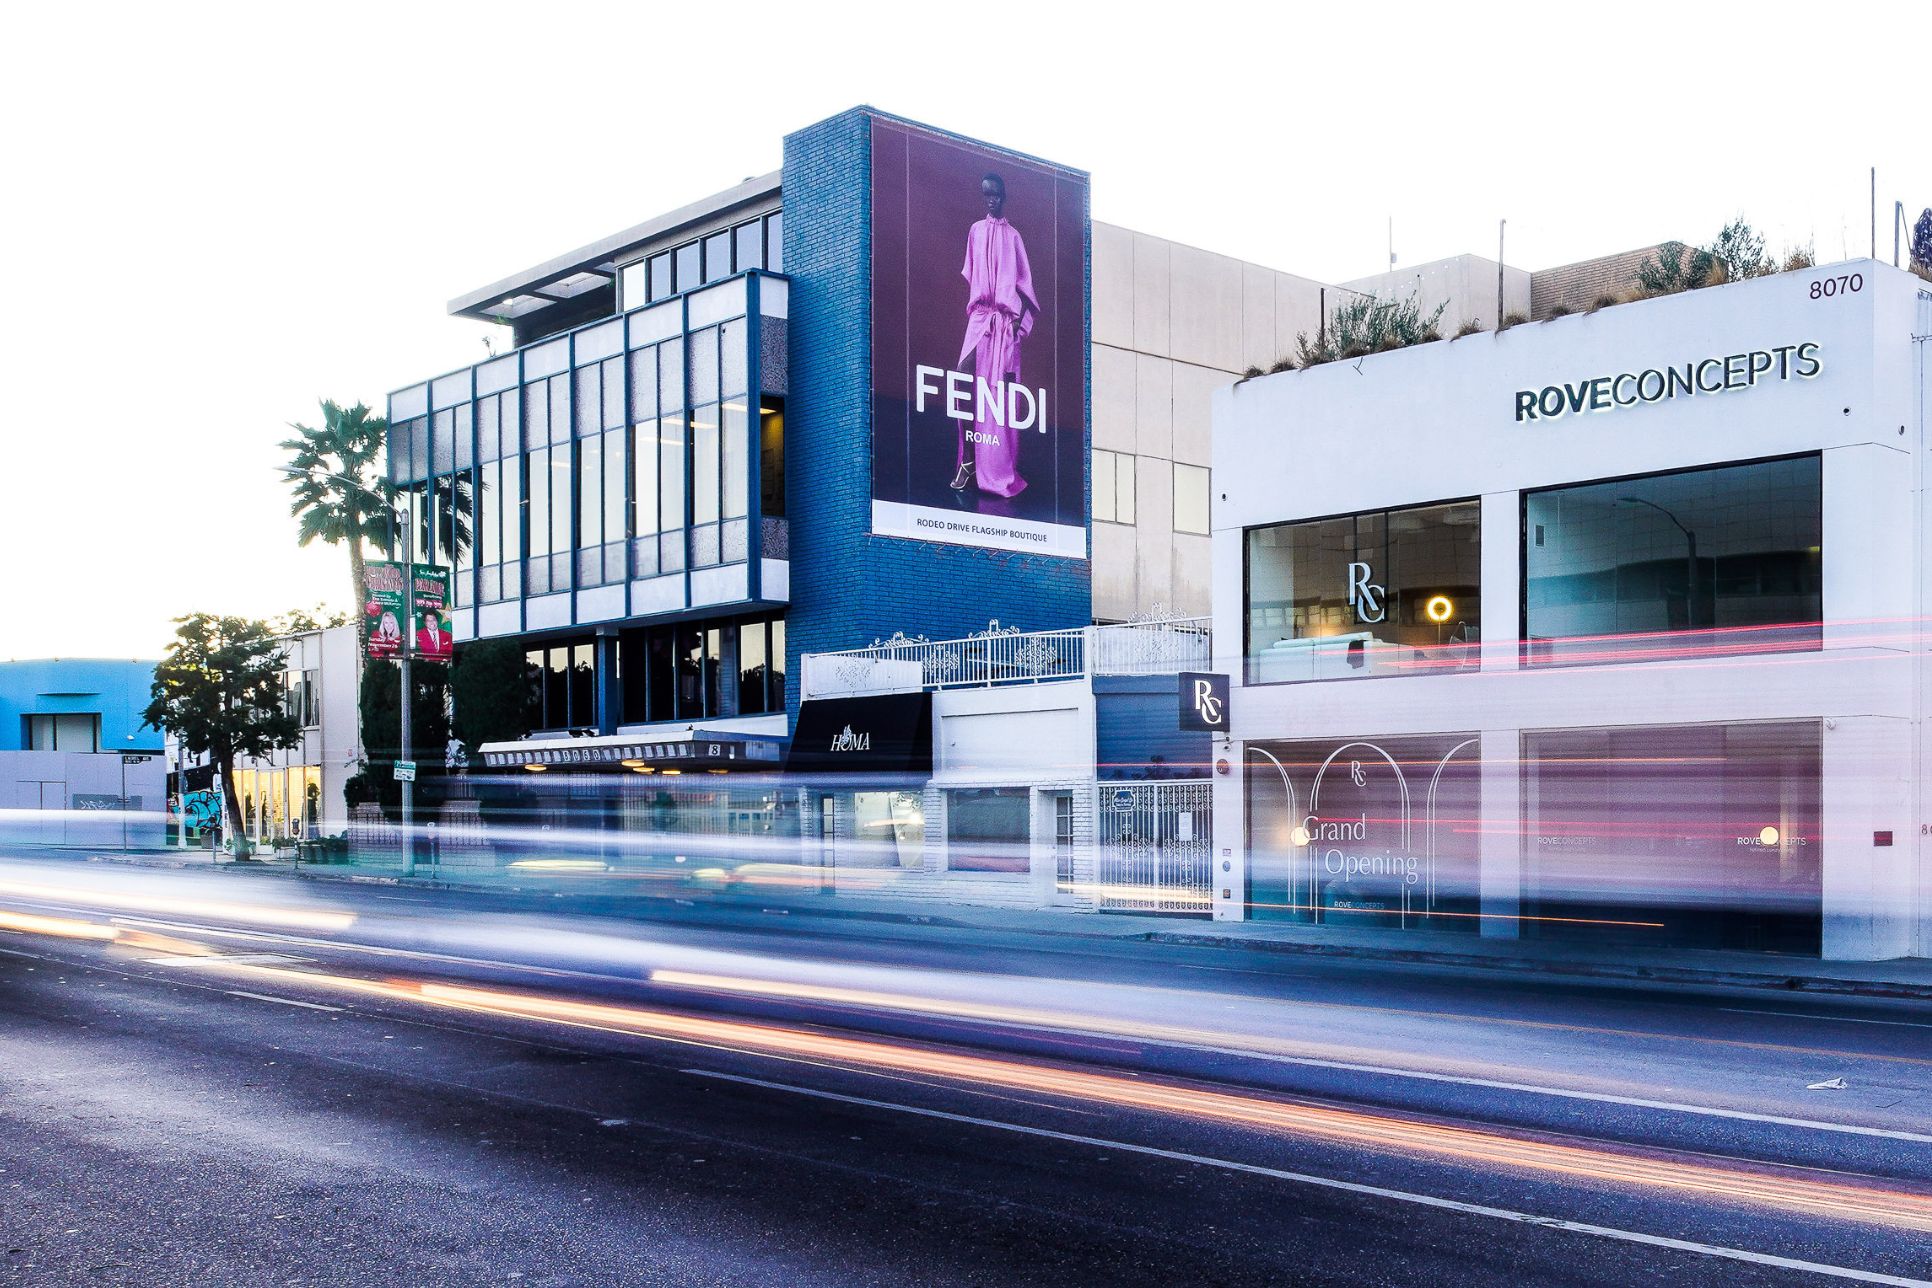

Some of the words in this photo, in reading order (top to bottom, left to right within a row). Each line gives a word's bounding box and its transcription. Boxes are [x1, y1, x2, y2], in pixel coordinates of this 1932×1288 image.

[1809, 273, 1864, 299] 8070
[1515, 342, 1821, 422] ROVECONCEPTS
[916, 364, 1047, 433] FENDI
[965, 430, 1000, 446] ROMA
[917, 518, 945, 529] RODEO
[947, 522, 970, 532] DRIVE
[971, 525, 1008, 536] FLAGSHIP
[1009, 530, 1047, 542] BOUTIQUE
[1194, 679, 1222, 724] RC
[711, 743, 719, 755] 8
[830, 732, 870, 751] HOMA
[1303, 813, 1366, 841] Grand
[1325, 849, 1418, 884] Opening
